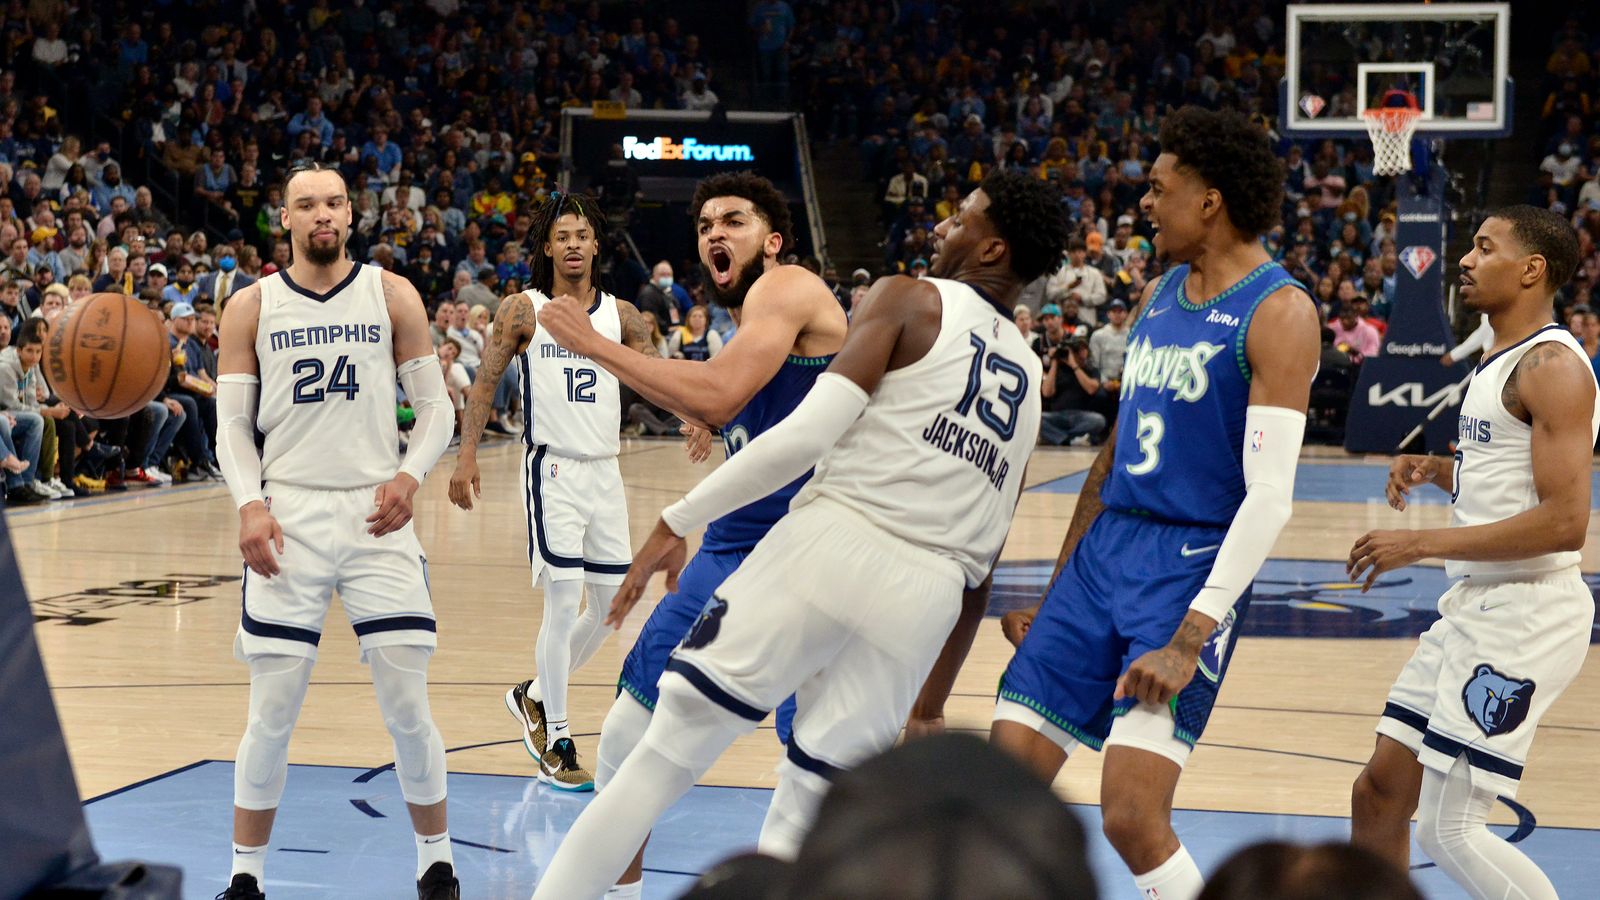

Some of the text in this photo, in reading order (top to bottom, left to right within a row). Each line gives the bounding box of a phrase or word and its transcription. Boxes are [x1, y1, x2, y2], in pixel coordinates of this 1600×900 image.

[270, 324, 381, 352] MEMPHIS
[1386, 341, 1446, 357] Google Pixel
[292, 355, 360, 405] 24
[563, 367, 597, 403] 12
[954, 331, 1029, 442] 13
[922, 412, 999, 477] JACKSON
[1126, 408, 1165, 476] 3
